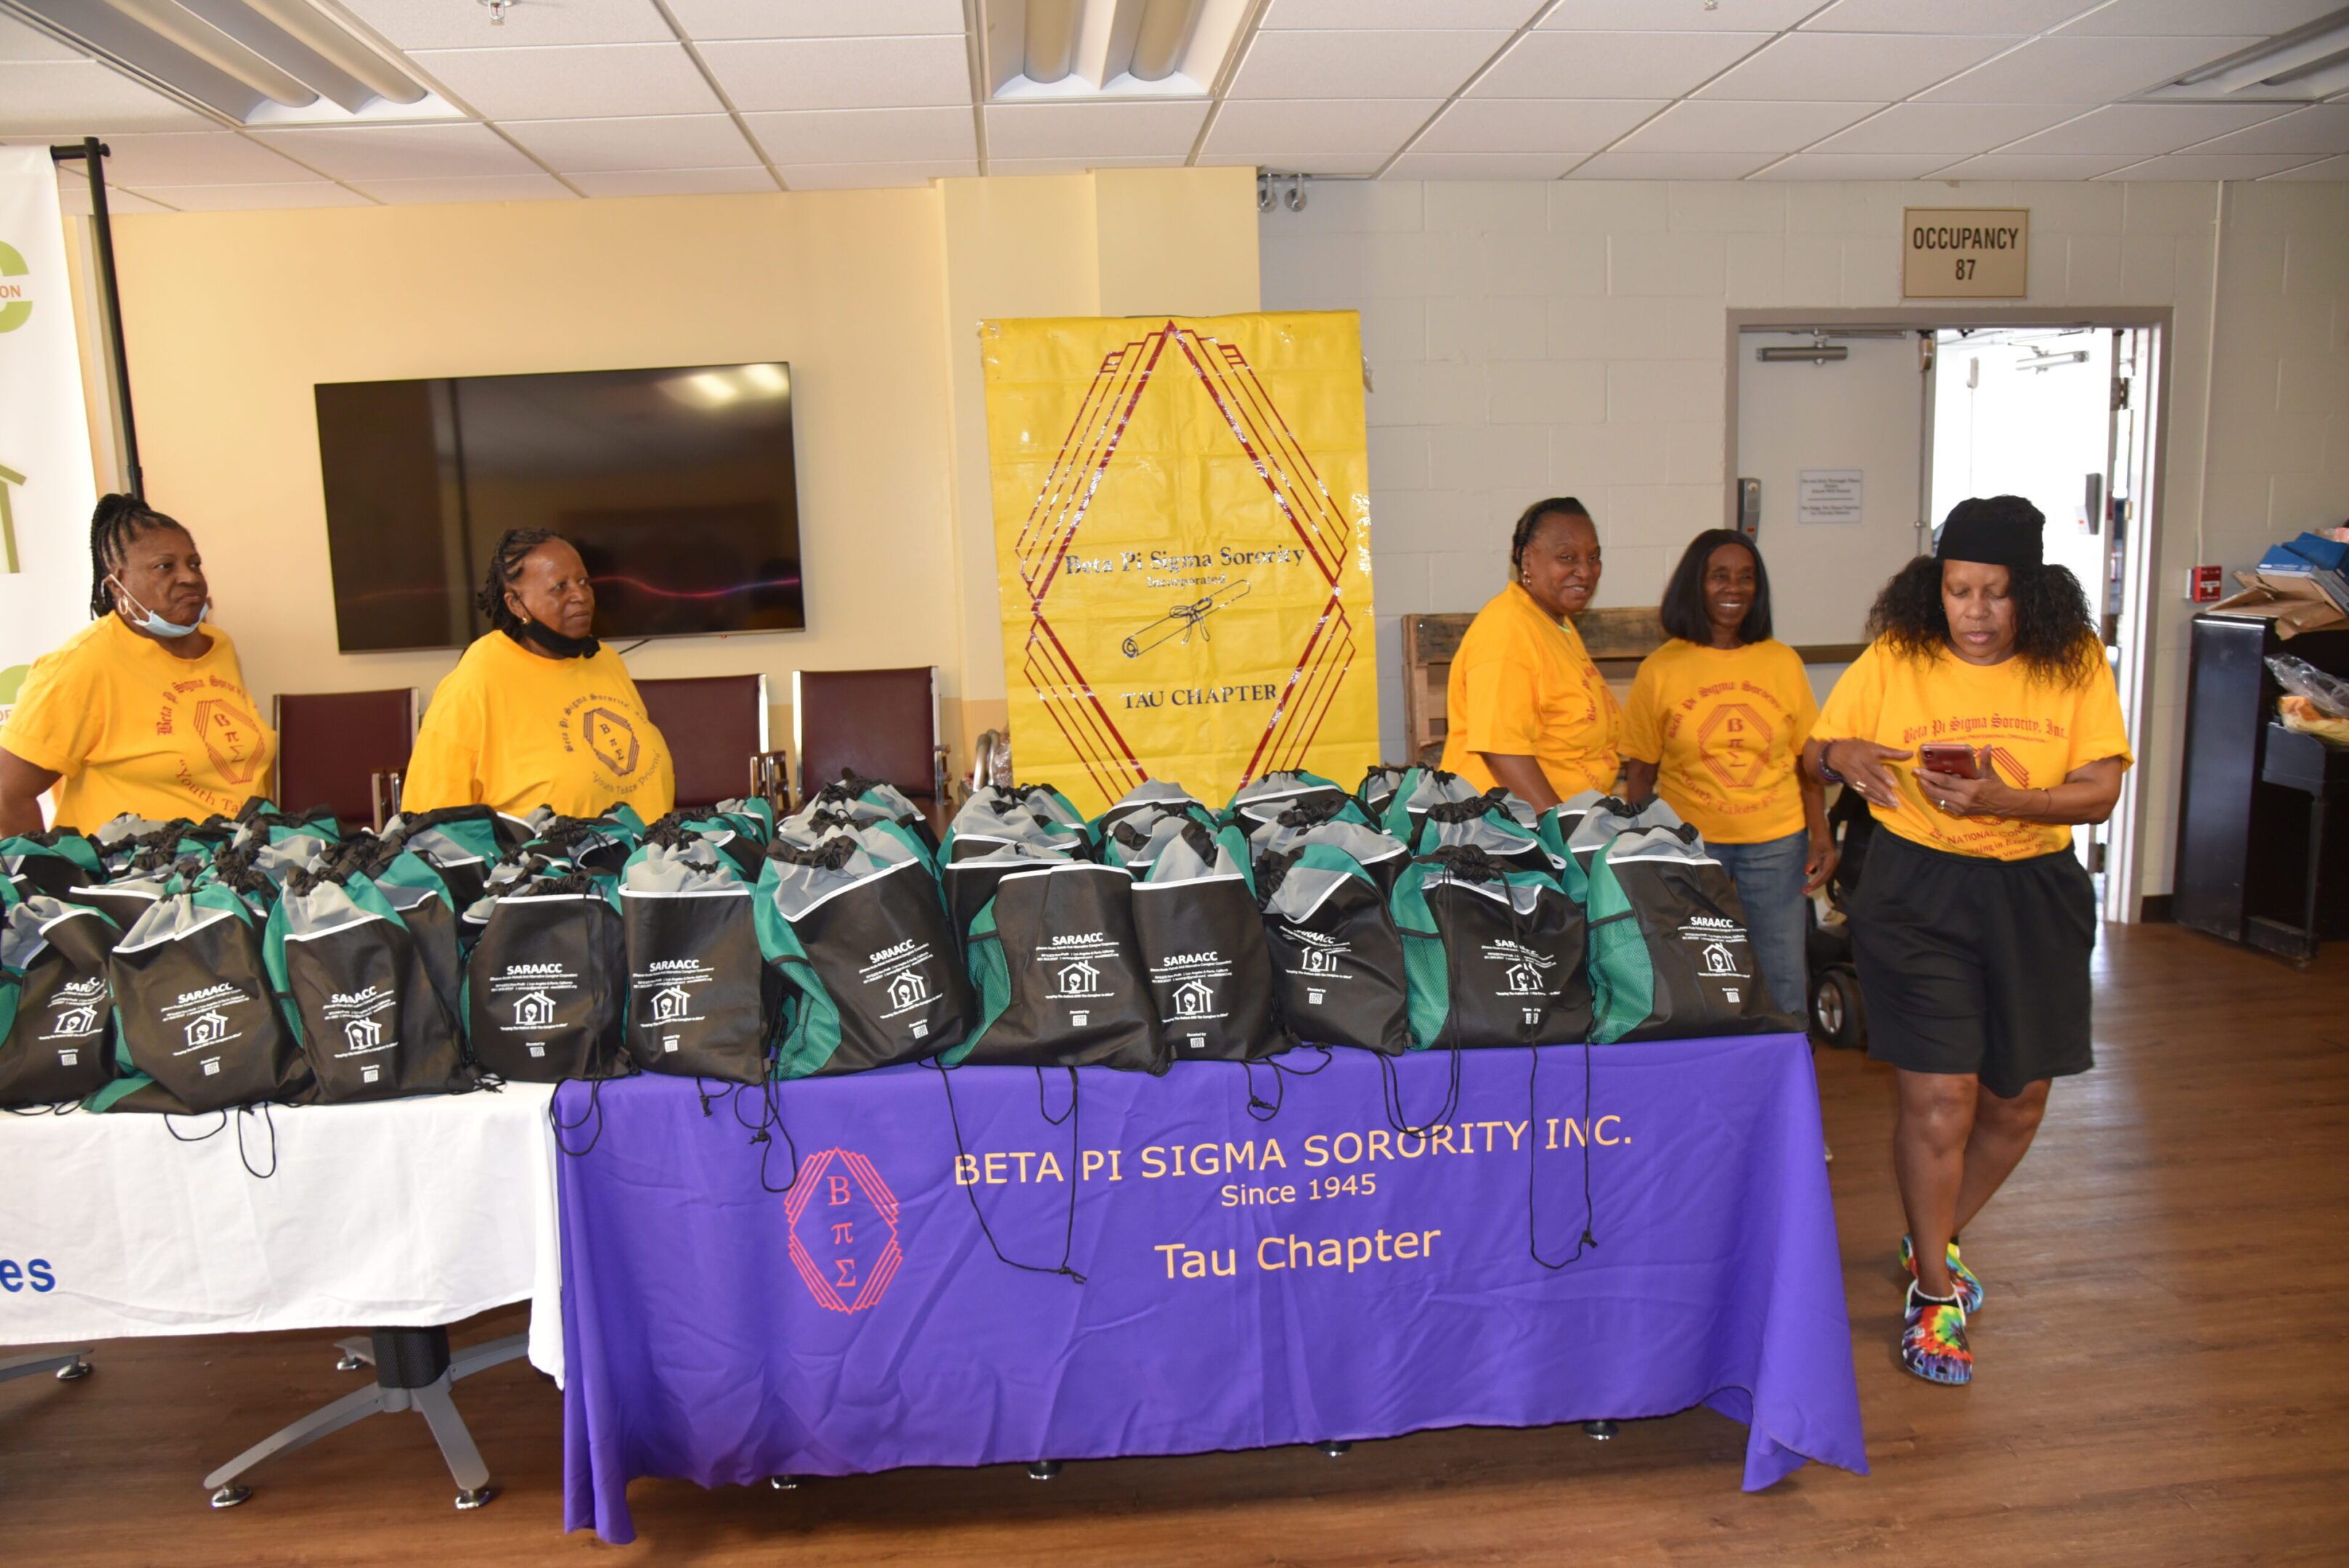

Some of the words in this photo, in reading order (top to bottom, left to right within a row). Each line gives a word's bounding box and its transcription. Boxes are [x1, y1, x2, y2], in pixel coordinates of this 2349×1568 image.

[1913, 226, 2019, 250] OCCUPANCY
[1955, 258, 1976, 280] 87
[1065, 554, 1113, 575] Beta
[1122, 550, 1143, 572] Pi
[1150, 550, 1213, 573] Sigma
[1220, 544, 1305, 566] Sorority
[1147, 573, 1227, 588] Incorporated
[1121, 690, 1164, 709] TAU
[1172, 684, 1278, 706] CHAPTER
[1697, 681, 1736, 698] Sigma
[1903, 725, 1928, 744] Beta
[1932, 719, 1946, 737] Pi
[1949, 716, 1988, 732] Sigma
[1990, 713, 2042, 734] Sorority,
[2044, 718, 2068, 740] Inc.
[1717, 799, 1760, 815] Takes
[1947, 830, 1997, 845] NATIONAL
[1690, 916, 1733, 928] SARAACC
[1052, 932, 1103, 945] SARAACC
[870, 939, 915, 963] SARAACC
[1163, 951, 1218, 967] SARAACC
[507, 963, 563, 976] SARAACC
[650, 959, 700, 972] SARAACC
[178, 982, 234, 1004] SARAACC
[954, 1151, 1065, 1186] BETA
[1082, 1149, 1123, 1181] PI
[1141, 1138, 1287, 1179] SIGMA
[1304, 1120, 1529, 1167] SORORITY
[1545, 1114, 1633, 1150] INC.
[1221, 1184, 1296, 1207] Since
[1308, 1173, 1377, 1201] 1945
[830, 1222, 854, 1245] π
[1154, 1243, 1237, 1279] Tau
[1257, 1228, 1442, 1273] Chapter
[0, 1258, 56, 1293] es
[836, 1258, 857, 1287] Σ
